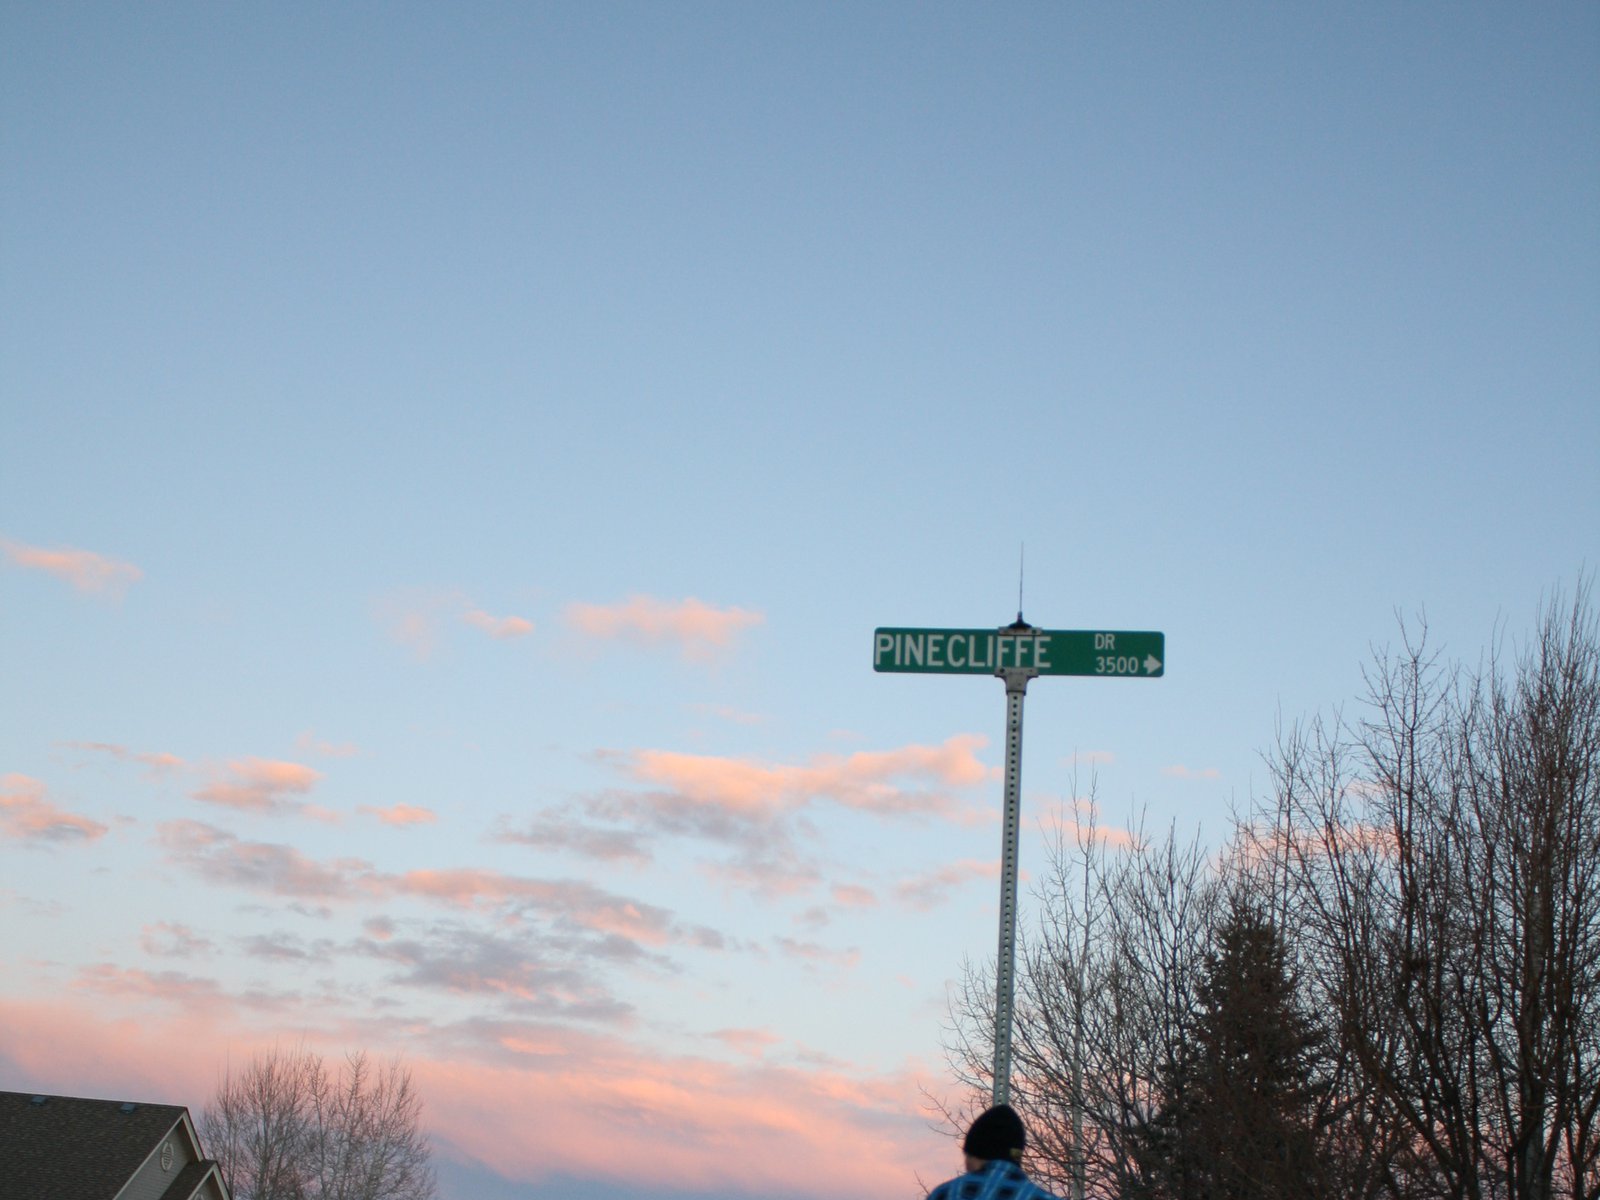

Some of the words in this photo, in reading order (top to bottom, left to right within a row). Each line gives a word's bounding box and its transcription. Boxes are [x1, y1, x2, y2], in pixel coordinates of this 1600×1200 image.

[1094, 633, 1115, 650] DR
[875, 634, 1051, 668] PINECLIFFE
[1095, 656, 1138, 674] 3500
